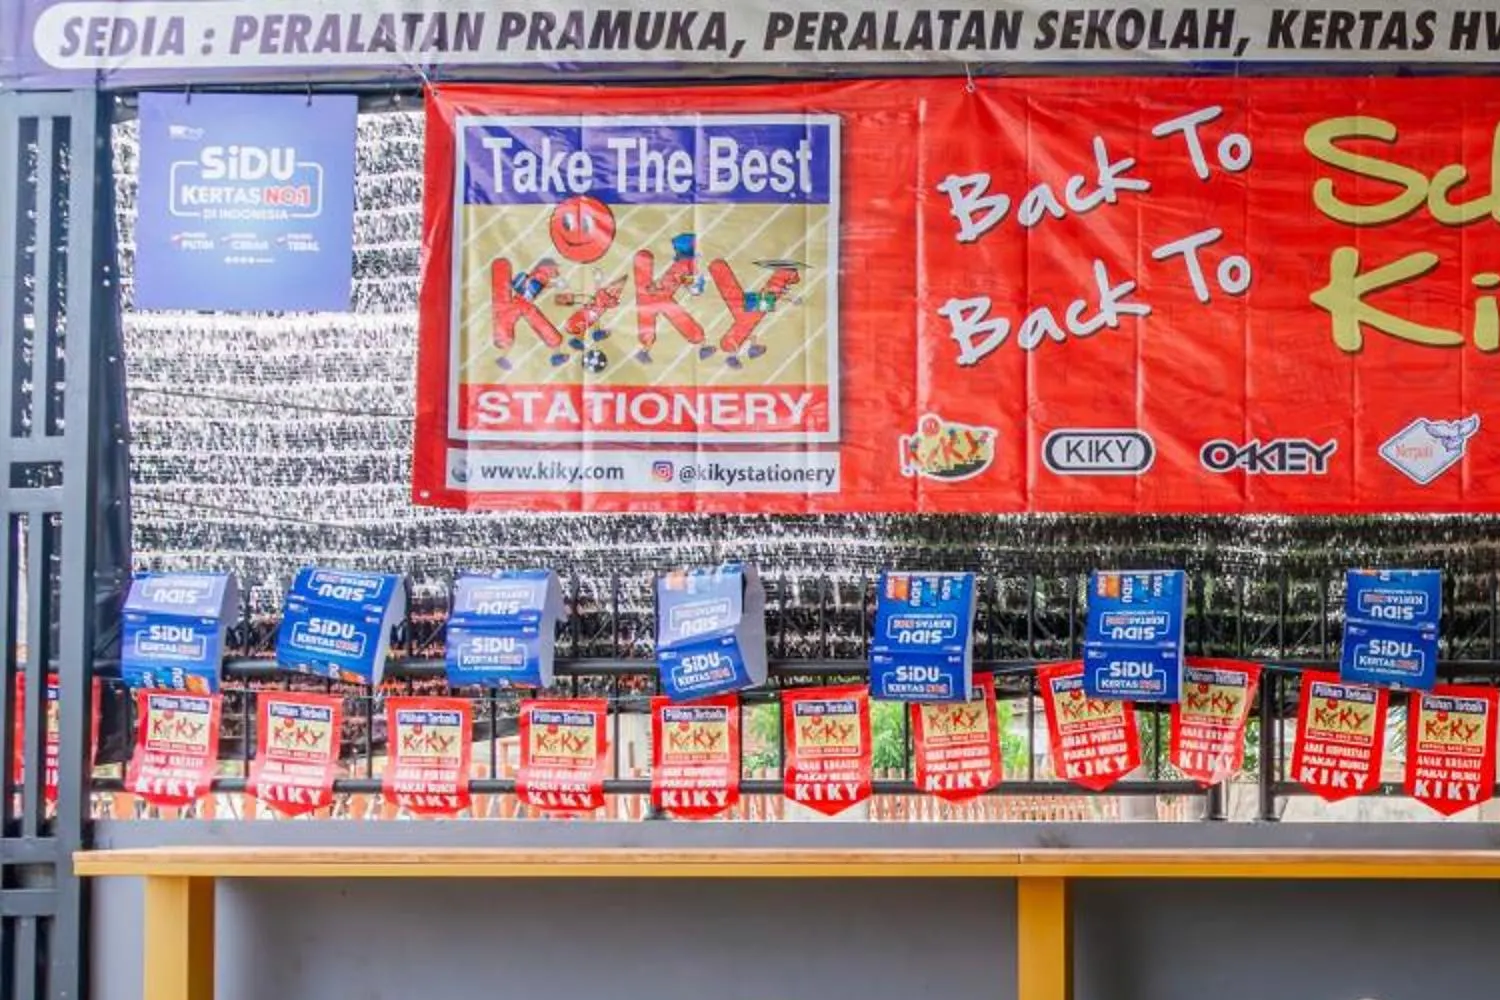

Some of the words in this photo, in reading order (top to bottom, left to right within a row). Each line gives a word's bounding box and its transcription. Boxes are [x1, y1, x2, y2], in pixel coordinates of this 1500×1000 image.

[60, 16, 185, 56] SEDIA
[229, 12, 484, 55] PERALATAN
[497, 10, 746, 58] PRAMUKA,
[763, 10, 1024, 52] PERALATAN
[1034, 10, 1251, 57] SEKOLAH,
[1268, 10, 1436, 51] KERTAS
[483, 137, 593, 193] Take
[608, 137, 693, 194] The
[709, 138, 812, 193] Best
[937, 136, 1151, 244] Back
[1152, 105, 1253, 181] To
[182, 185, 260, 205] KERTAS
[937, 259, 1151, 368] Back
[1152, 227, 1253, 305] To
[477, 391, 813, 426] STATIONERY
[1065, 440, 1132, 463] KIKY
[481, 461, 624, 483] www.kiky.com
[679, 464, 835, 485] @kikystationery
[1065, 758, 1130, 779] KIKY
[1179, 751, 1235, 772] KIKY
[135, 780, 197, 797] KIKY
[924, 770, 992, 791] KIKY
[1301, 766, 1369, 790] KIKY
[256, 784, 322, 805] KIKY
[528, 792, 592, 807] KIKY
[662, 790, 728, 808] KIKY
[793, 783, 860, 801] KIKY
[1414, 779, 1481, 800] KIKY
